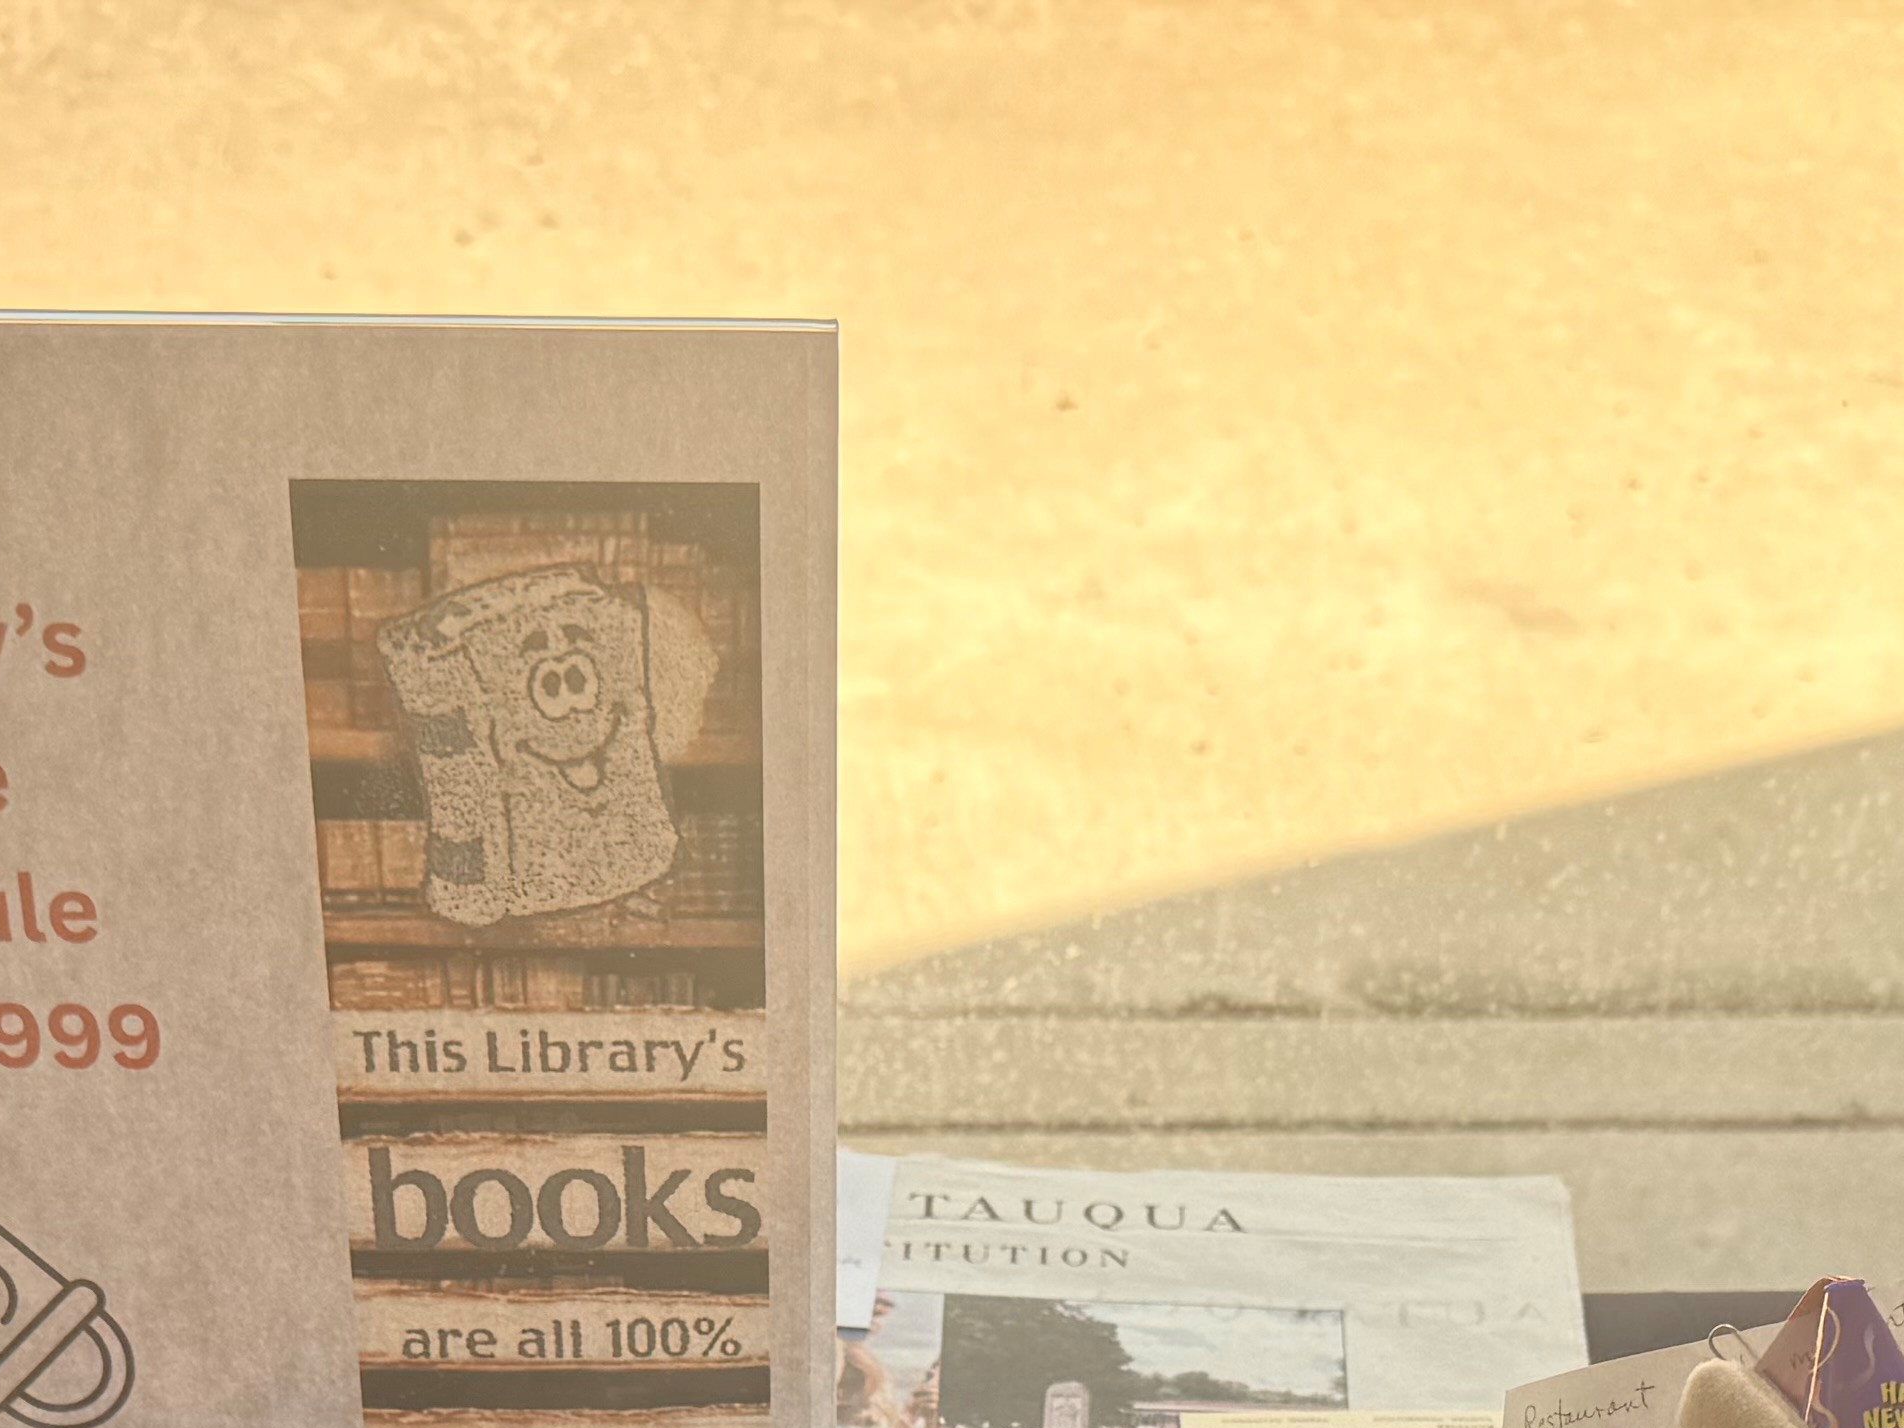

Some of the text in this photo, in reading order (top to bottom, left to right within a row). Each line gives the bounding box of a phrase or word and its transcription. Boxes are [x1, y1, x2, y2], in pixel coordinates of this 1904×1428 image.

[352, 1028, 746, 1082] This Library's
[364, 1144, 764, 1252] books
[400, 1317, 748, 1365] are all 100%
